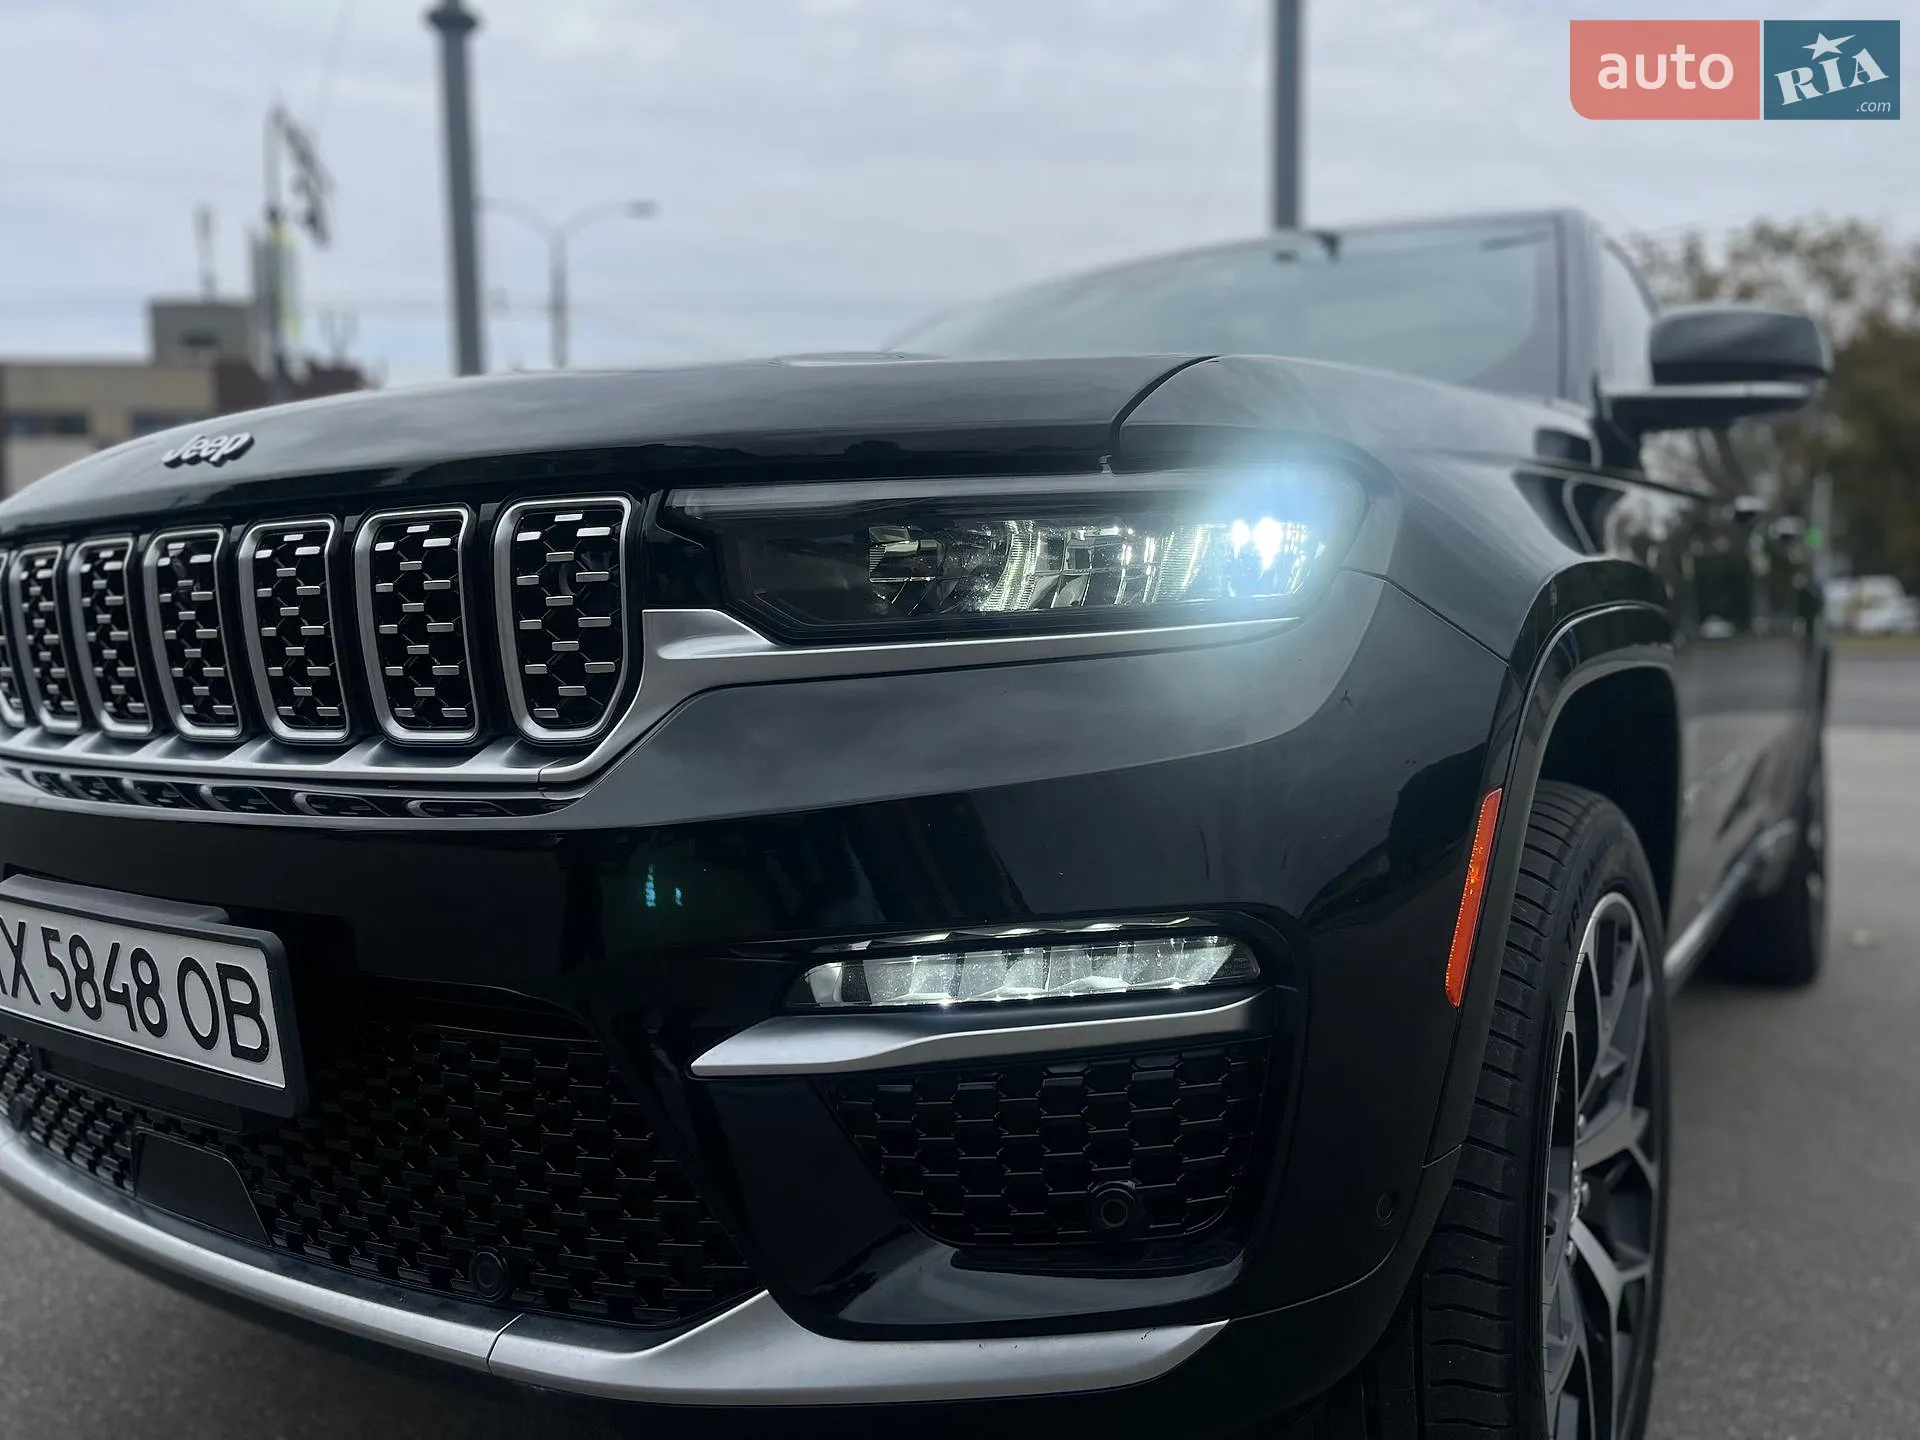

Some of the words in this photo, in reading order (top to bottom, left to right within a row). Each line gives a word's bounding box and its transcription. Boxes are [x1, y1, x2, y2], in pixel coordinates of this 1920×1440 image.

[161, 432, 255, 468] Jeep
[0, 914, 41, 1006] X
[40, 925, 169, 1039] 5848
[176, 956, 271, 1063] OB
